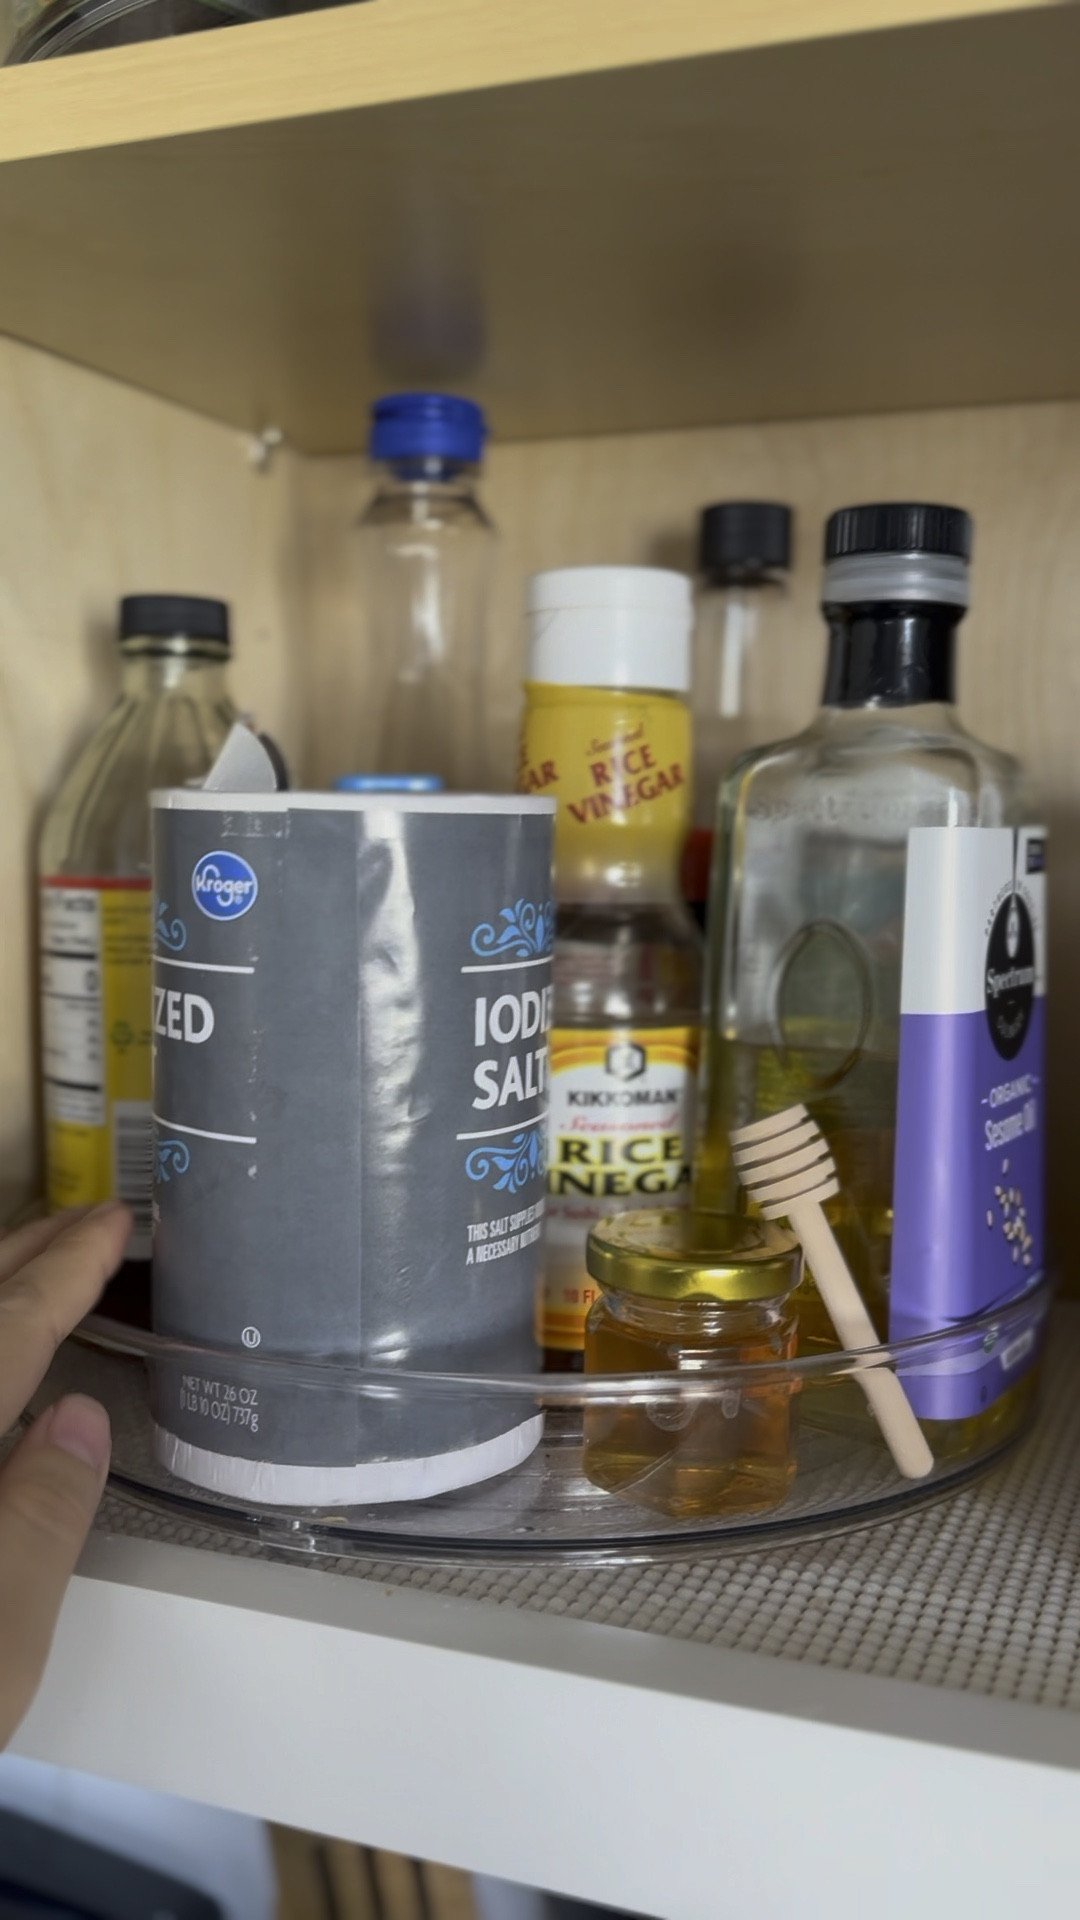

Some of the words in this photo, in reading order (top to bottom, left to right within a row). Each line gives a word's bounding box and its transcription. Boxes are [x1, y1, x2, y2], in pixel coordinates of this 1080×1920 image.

[589, 744, 657, 787] RICE
[566, 762, 685, 824] VINEGAR
[196, 864, 252, 907] Kroger
[472, 1047, 550, 1110] SALT
[567, 1089, 678, 1107] KIKKOMAN
[559, 1136, 684, 1165] RICE
[467, 1222, 489, 1243] THIS
[489, 1216, 509, 1238] SALT
[466, 1247, 474, 1266] A
[223, 1384, 237, 1402] 26
[239, 1387, 259, 1406] OZ
